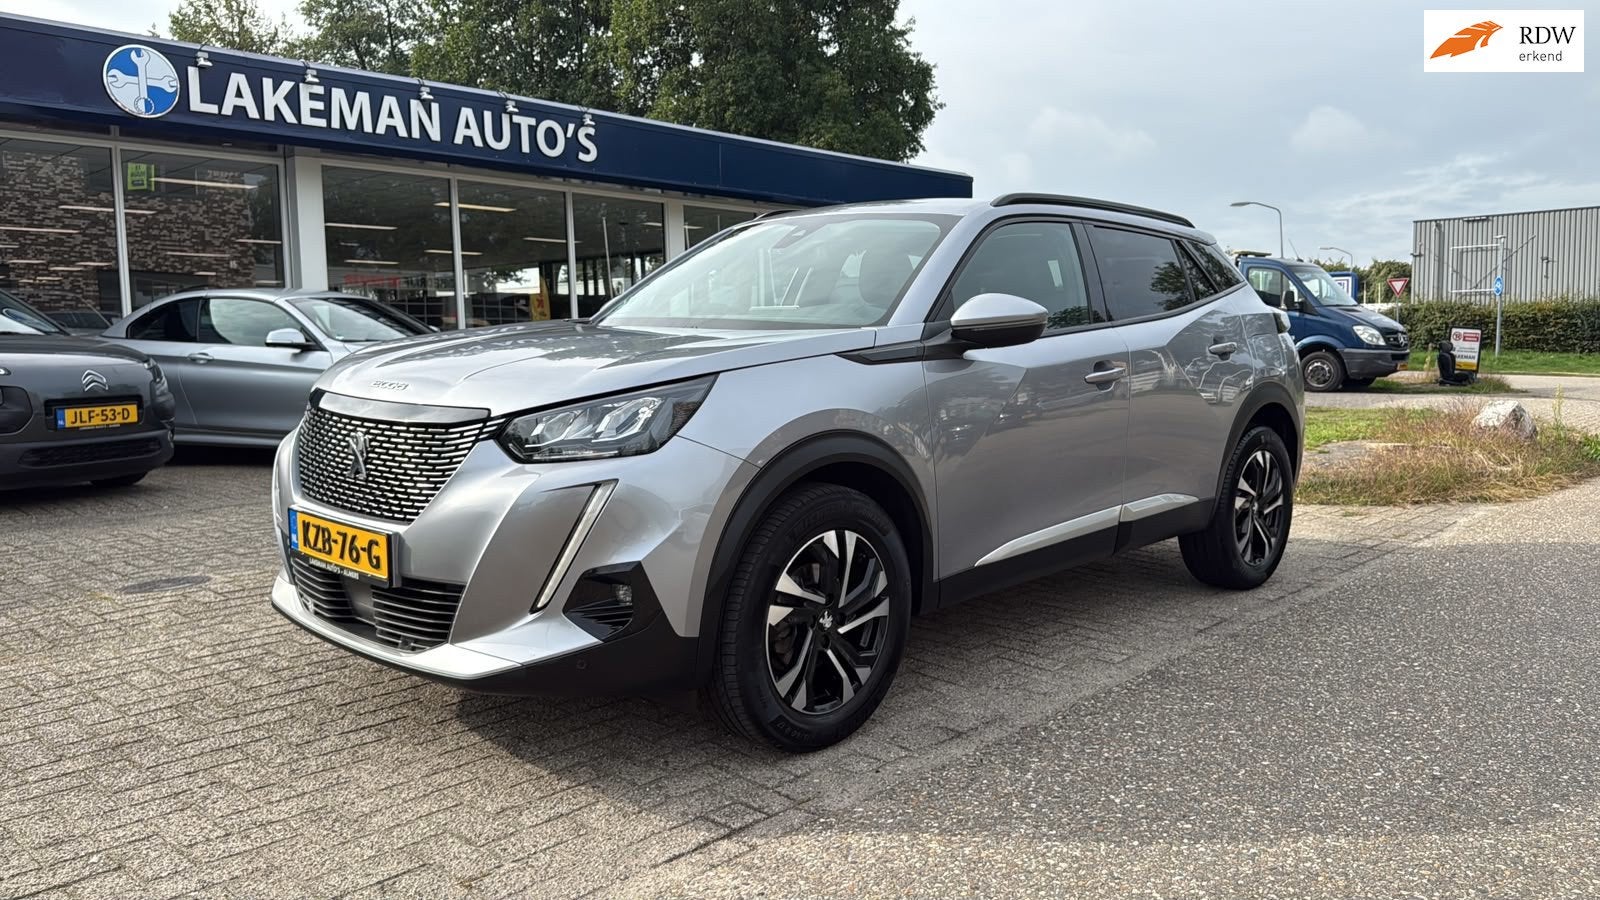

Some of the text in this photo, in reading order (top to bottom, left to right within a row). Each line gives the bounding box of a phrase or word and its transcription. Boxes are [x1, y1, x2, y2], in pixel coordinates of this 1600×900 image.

[187, 65, 598, 163] LAKEMAN AUTO'S
[71, 407, 130, 425] JLF-53-D
[302, 519, 381, 570] KZB-76-G
